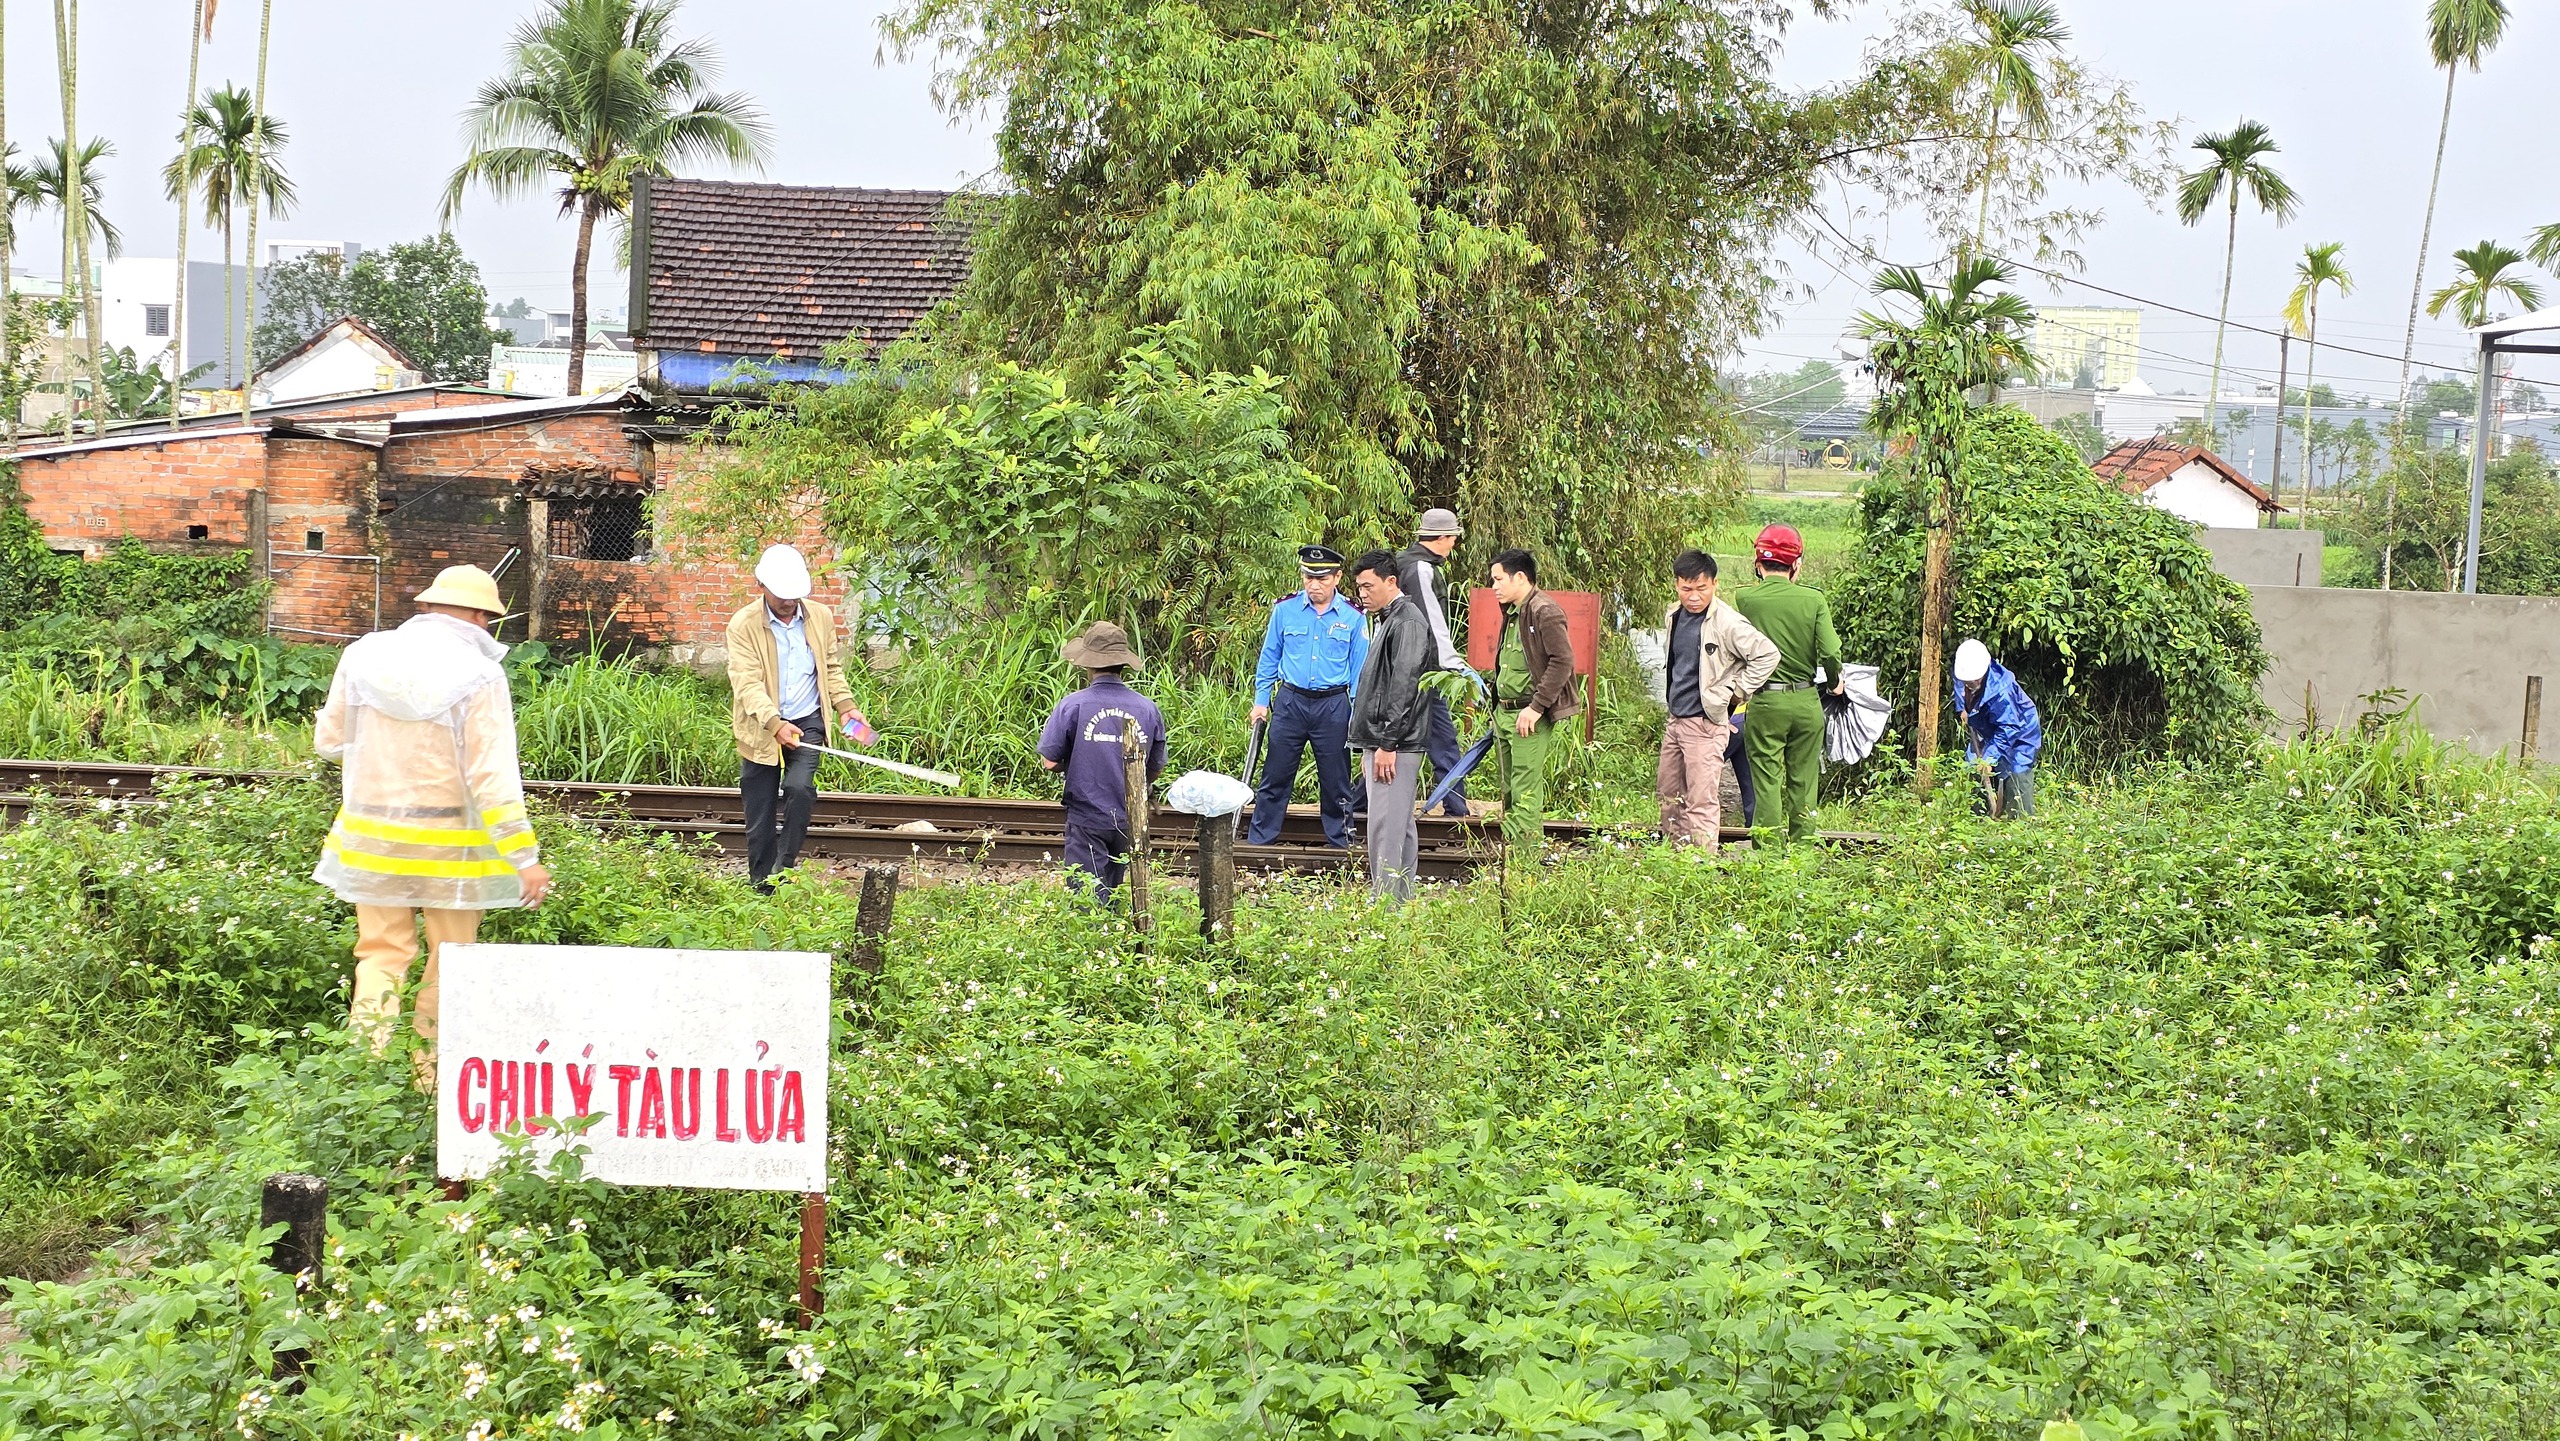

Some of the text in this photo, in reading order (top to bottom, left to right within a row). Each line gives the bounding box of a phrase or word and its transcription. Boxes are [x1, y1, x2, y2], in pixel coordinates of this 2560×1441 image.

[457, 1039, 806, 1144] CHÚ Ý TÀU LỬA
